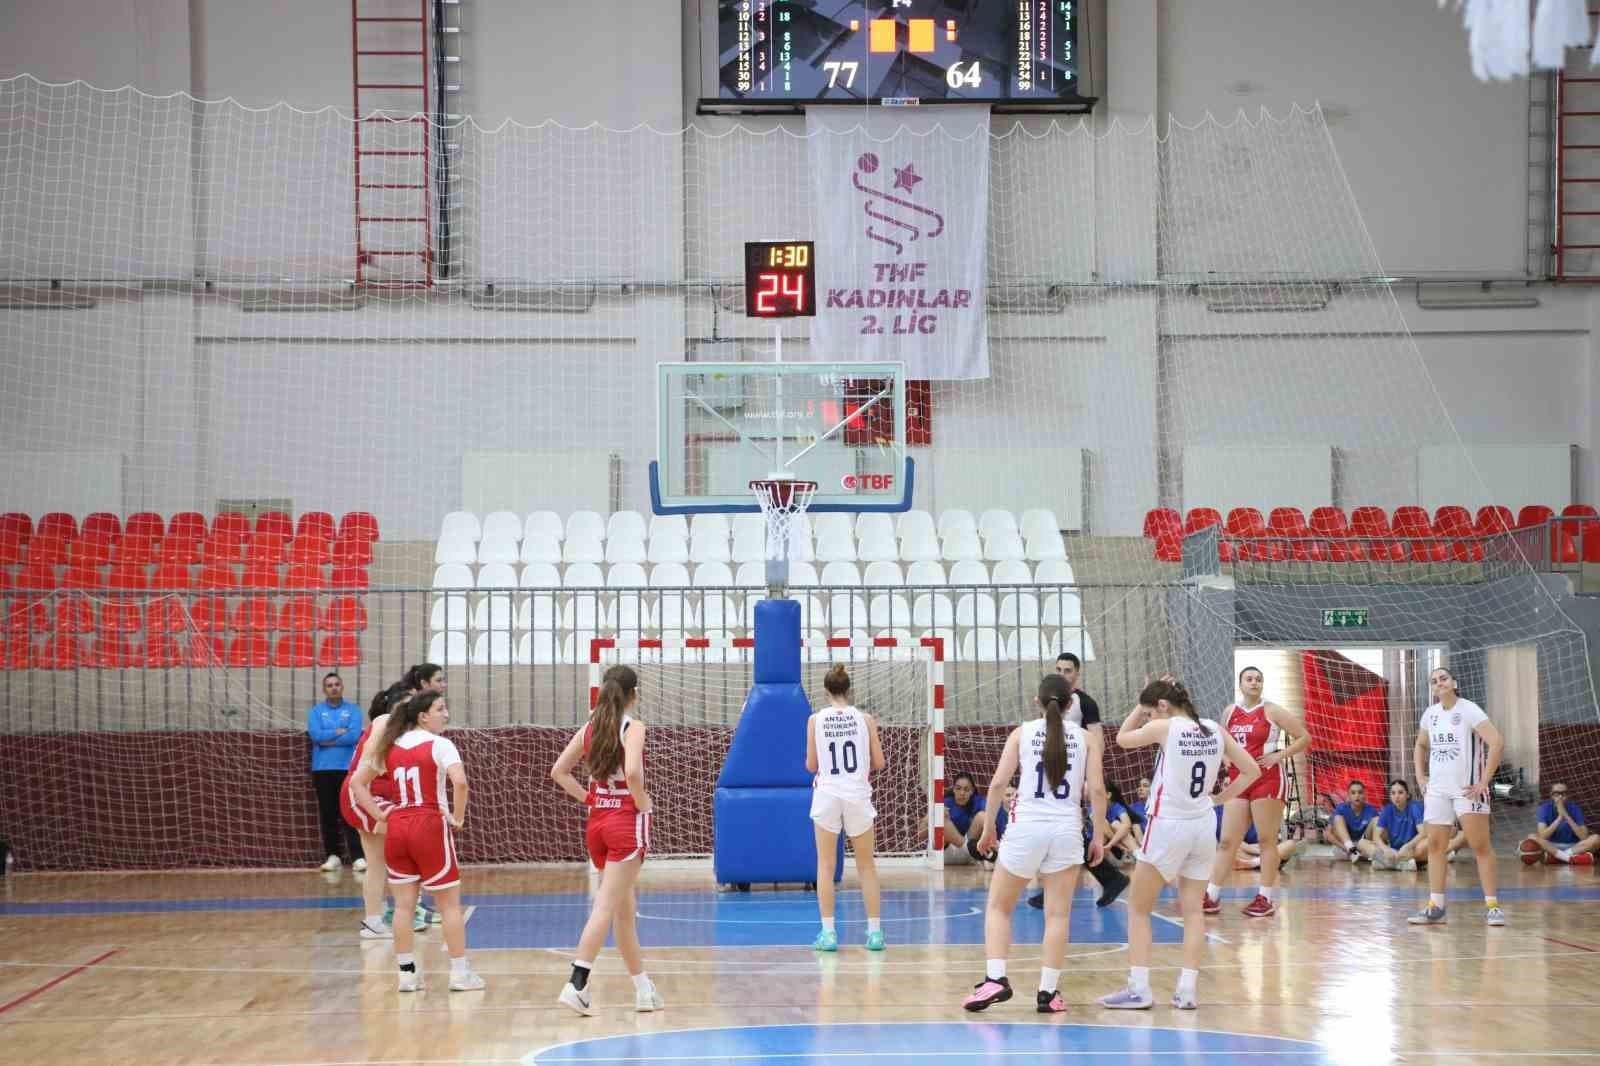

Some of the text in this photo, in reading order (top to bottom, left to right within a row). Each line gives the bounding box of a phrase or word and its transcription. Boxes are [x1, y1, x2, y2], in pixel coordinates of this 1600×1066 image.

[742, 2, 766, 11] 9 2
[1019, 2, 1072, 11] 11 2 14
[739, 12, 791, 21] 10 2 18
[1019, 12, 1071, 20] 13 4 3
[739, 22, 749, 31] 11
[1019, 22, 1071, 30] 16 2 1
[739, 32, 791, 41] 12 3 8
[1019, 32, 1047, 41] 18 2
[739, 42, 791, 51] 13 6
[1018, 41, 1071, 51] 21 5 5
[739, 52, 791, 61] 14 3 13
[1018, 51, 1071, 61] 22 3 3
[739, 62, 791, 71] 15 4 4
[1018, 61, 1031, 70] 24
[738, 72, 750, 81] 30
[823, 61, 859, 89] 77
[946, 61, 982, 89] 64
[1018, 71, 1072, 80] 54 1 8
[737, 82, 750, 91] 99
[1018, 81, 1031, 91] 99
[769, 245, 809, 267] 1:30
[757, 273, 804, 312] 24
[826, 288, 972, 309] KADINLAR
[861, 309, 938, 335] 2. LİG
[858, 474, 894, 490] TBF
[1034, 730, 1076, 741] ANYA
[828, 740, 858, 775] 10
[1190, 761, 1206, 798] 8
[393, 766, 424, 808] 11
